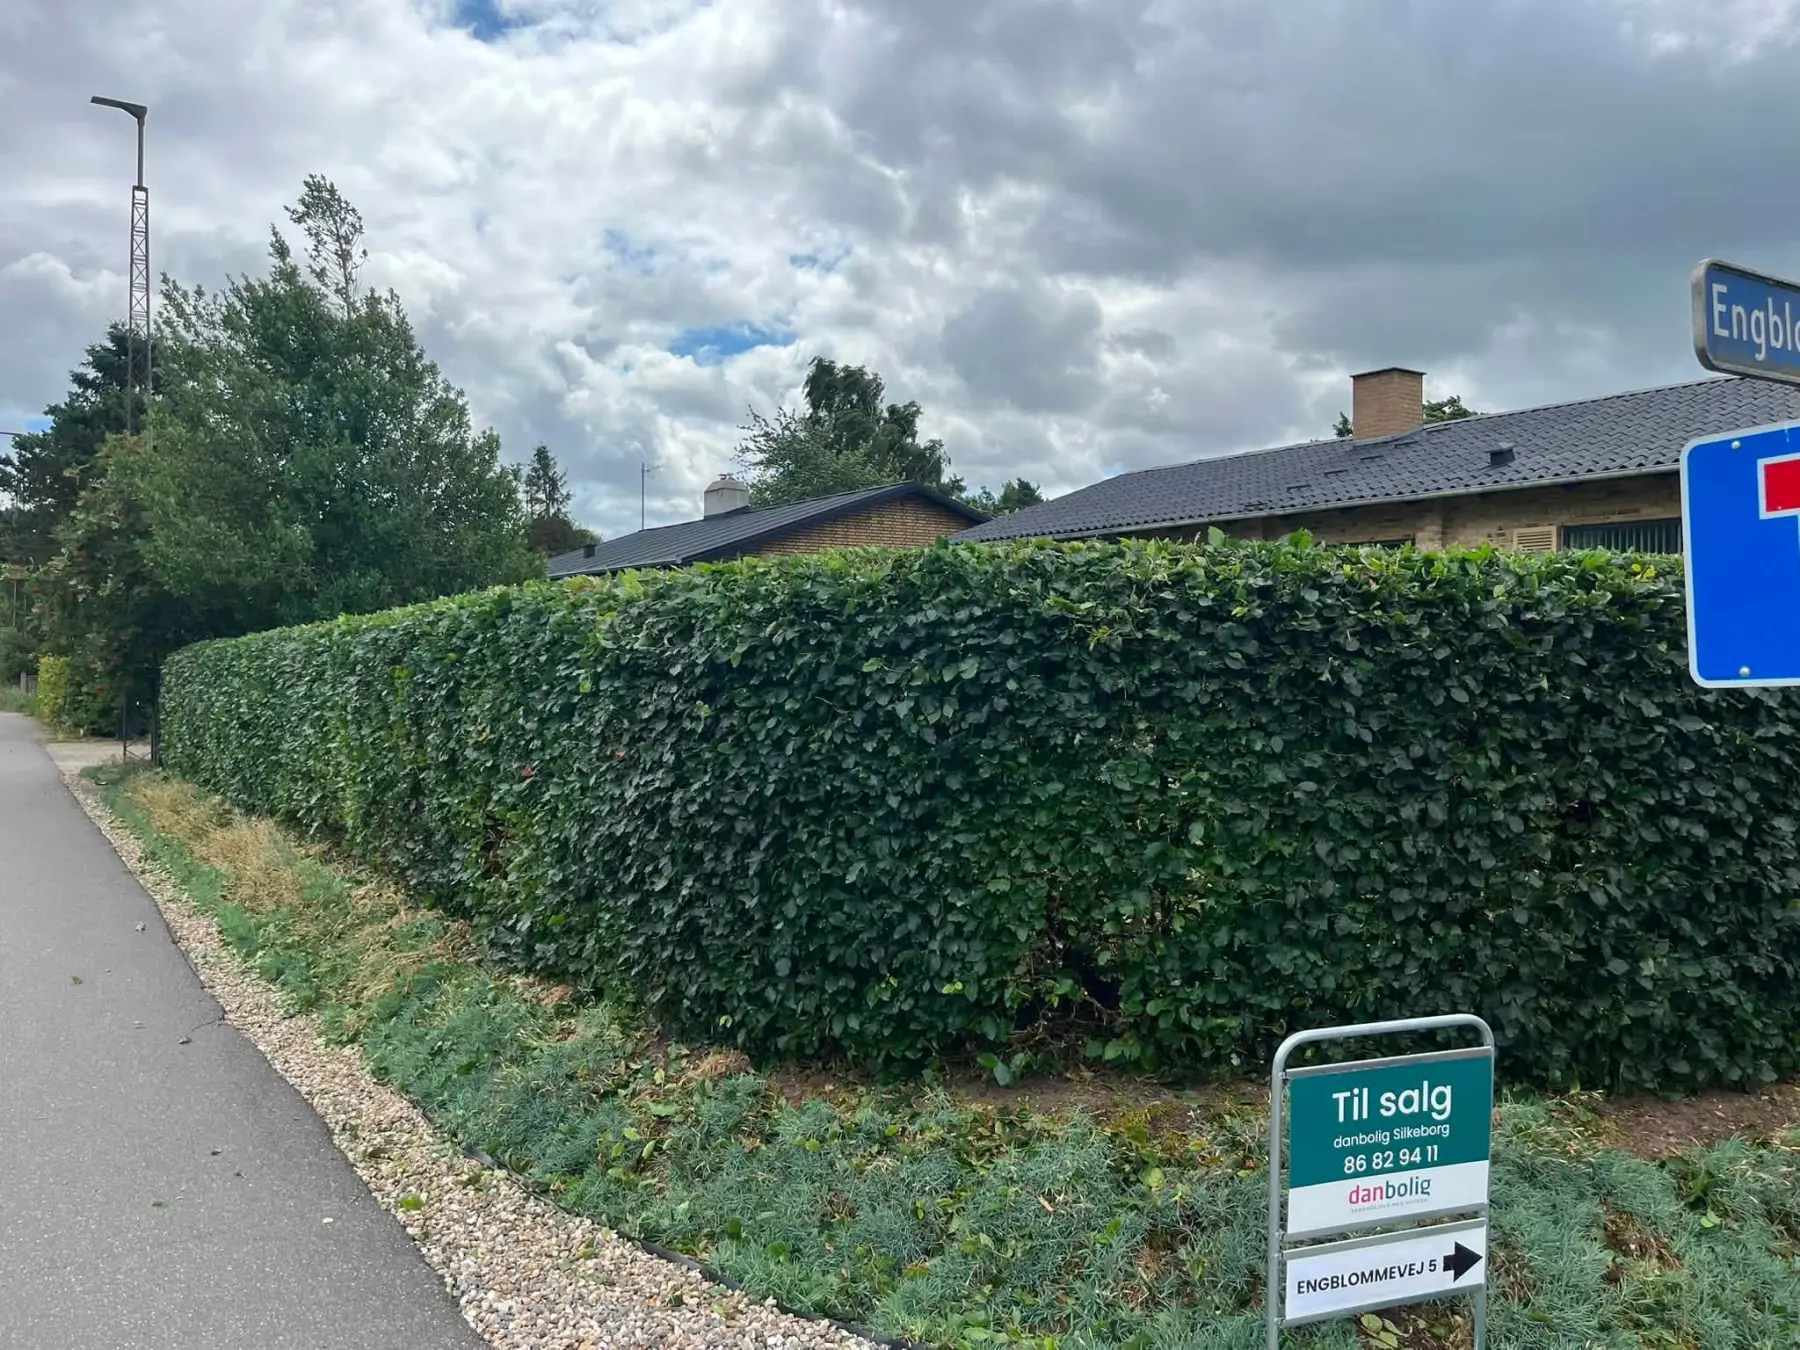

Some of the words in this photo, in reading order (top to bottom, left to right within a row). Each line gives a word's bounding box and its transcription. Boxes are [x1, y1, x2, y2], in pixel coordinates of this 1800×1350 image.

[1332, 1087, 1368, 1123] Til
[1380, 1080, 1452, 1121] salg
[1333, 1130, 1390, 1148] danbolig
[1393, 1124, 1450, 1140] Silkeborg
[1344, 1154, 1366, 1174] 86
[1372, 1150, 1394, 1170] 82
[1399, 1147, 1421, 1165] 94
[1426, 1144, 1438, 1162] 11
[1349, 1176, 1431, 1204] danbolig
[1297, 1261, 1424, 1294] ENGBLOMMEVEJ
[1428, 1259, 1437, 1272] 5
